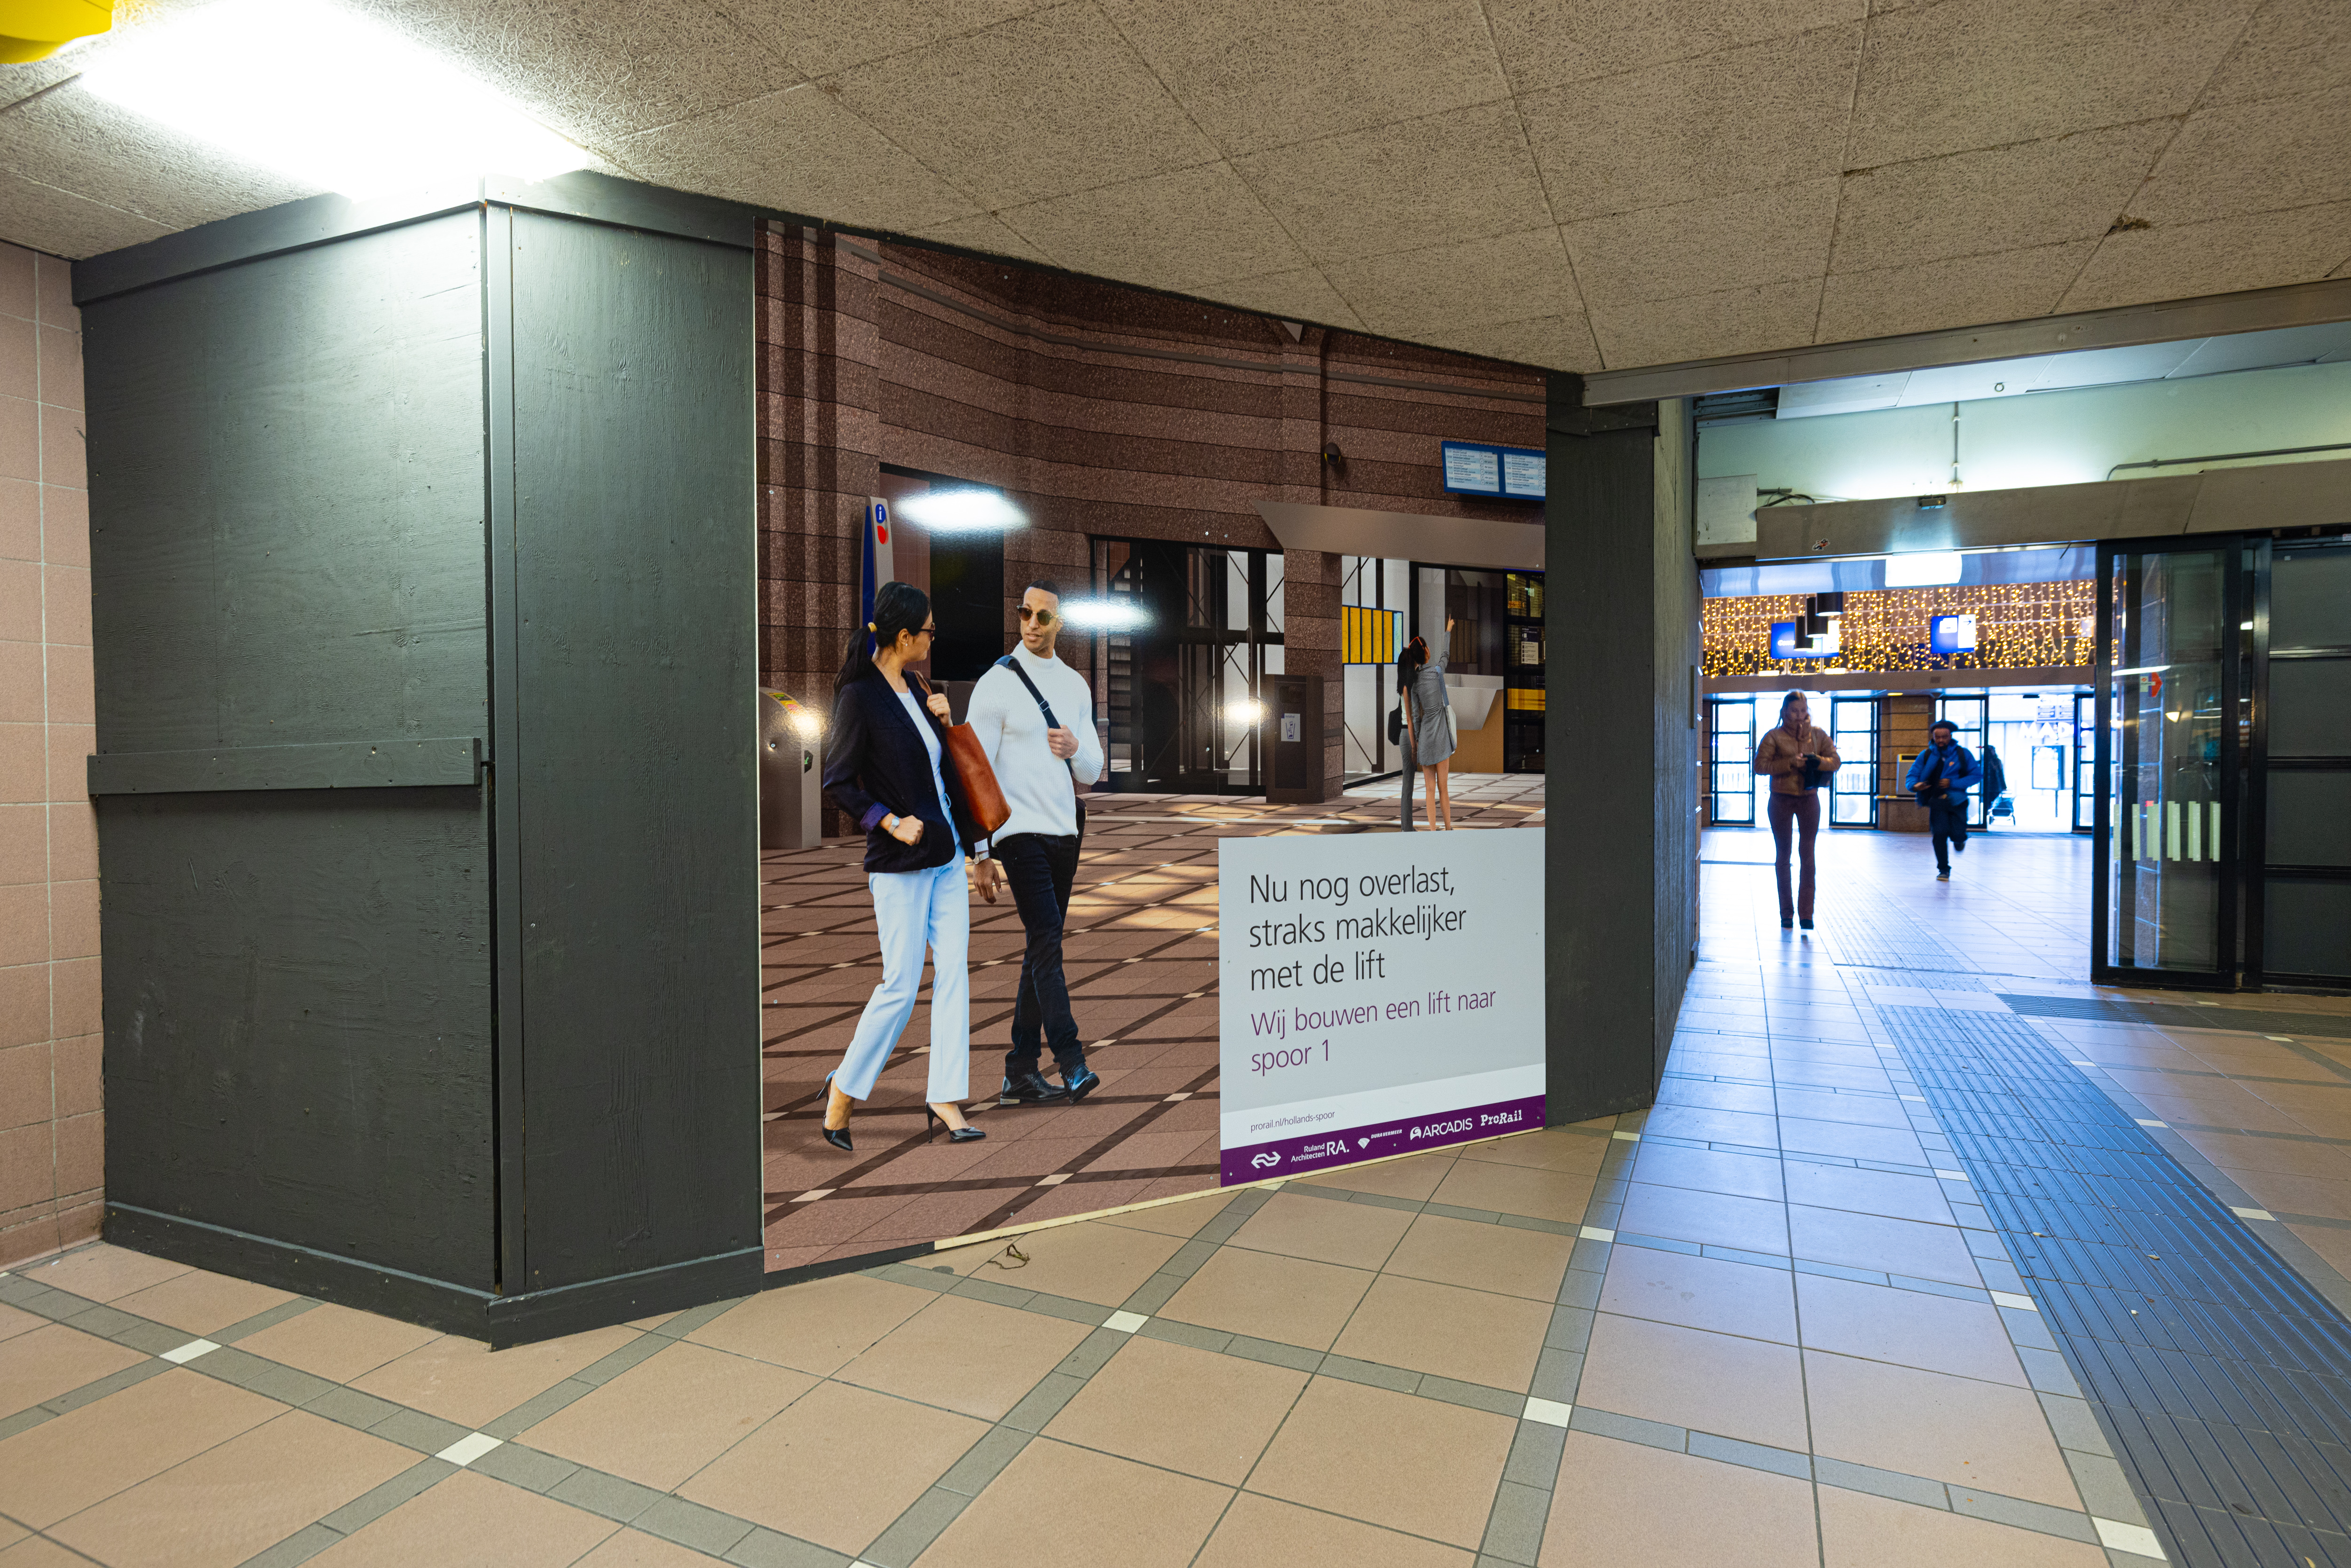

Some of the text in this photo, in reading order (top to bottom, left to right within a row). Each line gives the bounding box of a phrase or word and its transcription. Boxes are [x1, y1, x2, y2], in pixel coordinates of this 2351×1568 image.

[1250, 865, 1455, 906] Nu nog overlast,
[1249, 904, 1467, 948] straks makkelijker
[1251, 949, 1386, 991] met de lift
[1251, 990, 1496, 1040] Wij bouwen een lift naar
[1251, 1039, 1329, 1077] spoor 1
[1251, 1111, 1335, 1134] prorail.nl/hollands-spoor
[1422, 1118, 1473, 1139] ARCADIS
[1480, 1109, 1523, 1127] ProRail
[1291, 1151, 1325, 1163] Architecten
[1303, 1143, 1325, 1153] Ruland
[1326, 1139, 1349, 1156] RA.
